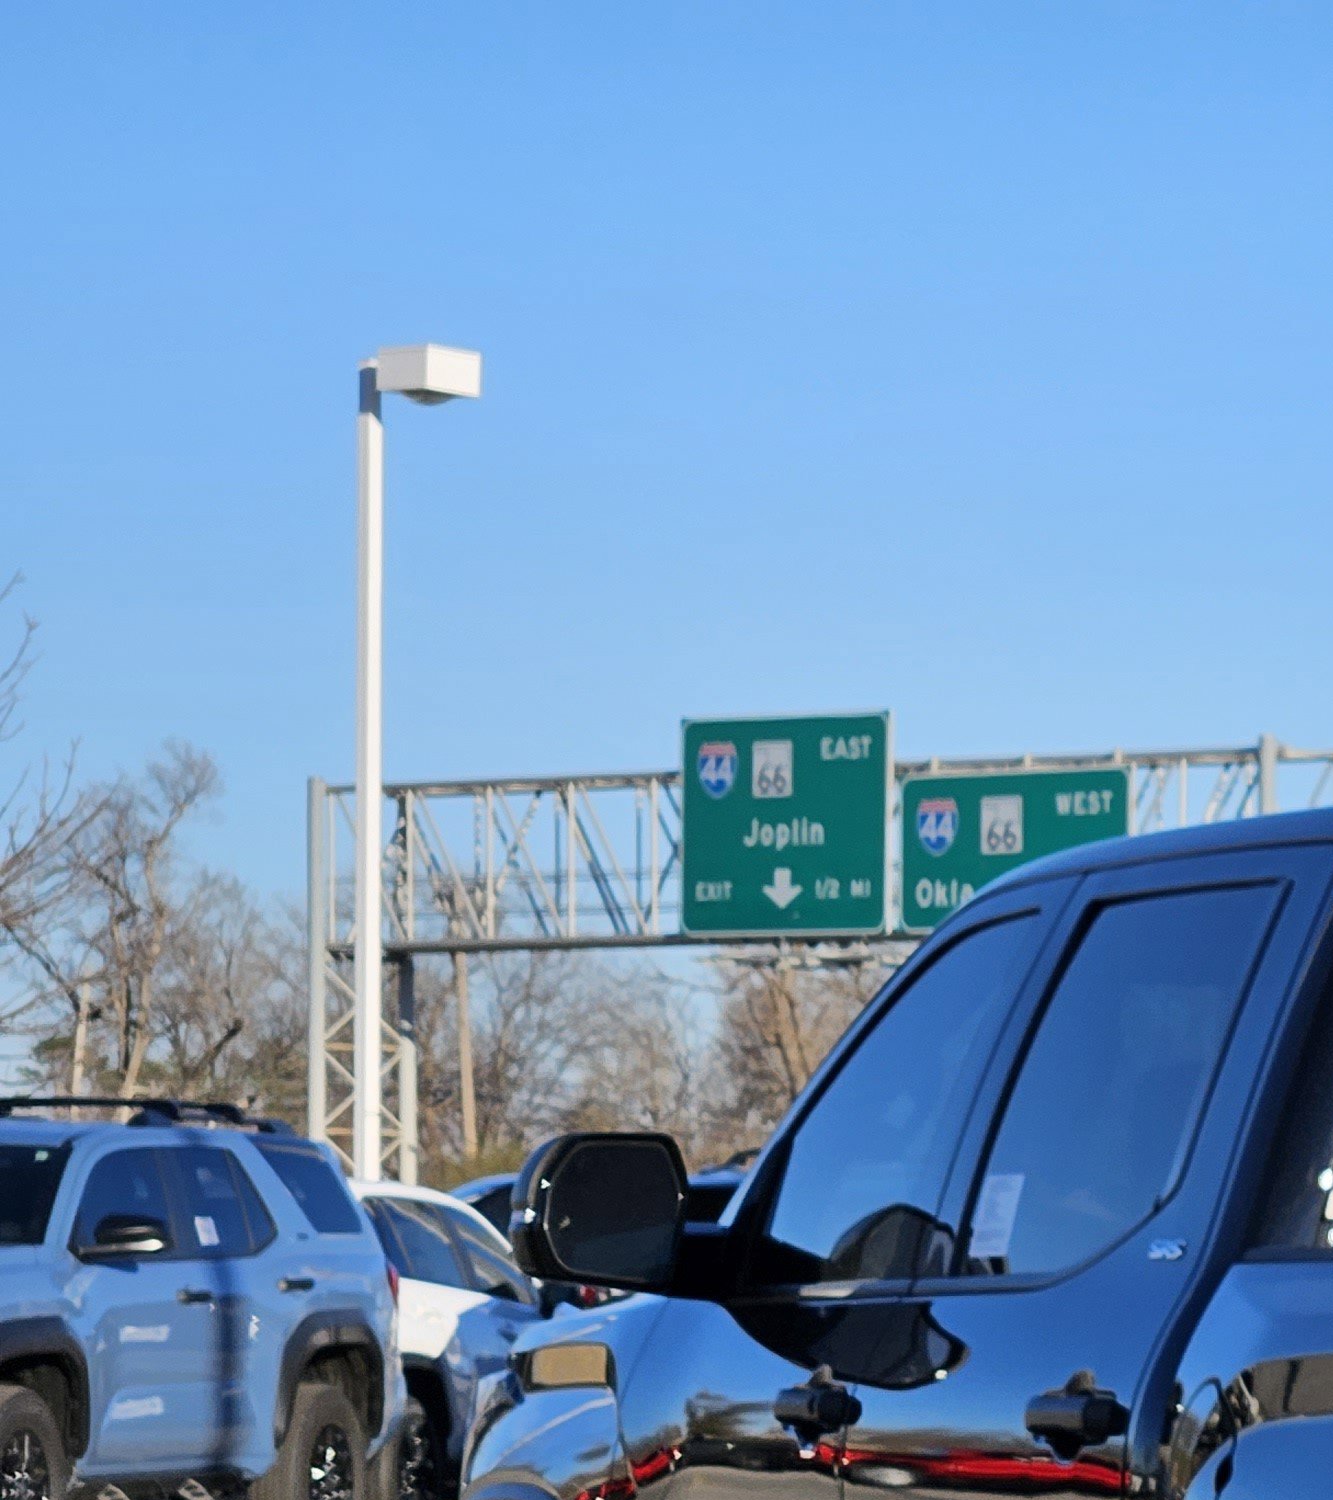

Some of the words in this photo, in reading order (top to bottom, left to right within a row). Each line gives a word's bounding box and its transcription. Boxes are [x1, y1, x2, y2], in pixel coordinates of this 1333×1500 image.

[820, 735, 872, 761] EAST
[700, 755, 733, 784] 44
[757, 761, 786, 794] 66
[1056, 790, 1114, 816] WEST
[743, 816, 825, 851] Joplin
[918, 811, 953, 840] 44
[987, 818, 1017, 850] 66
[695, 880, 733, 901] EXIT
